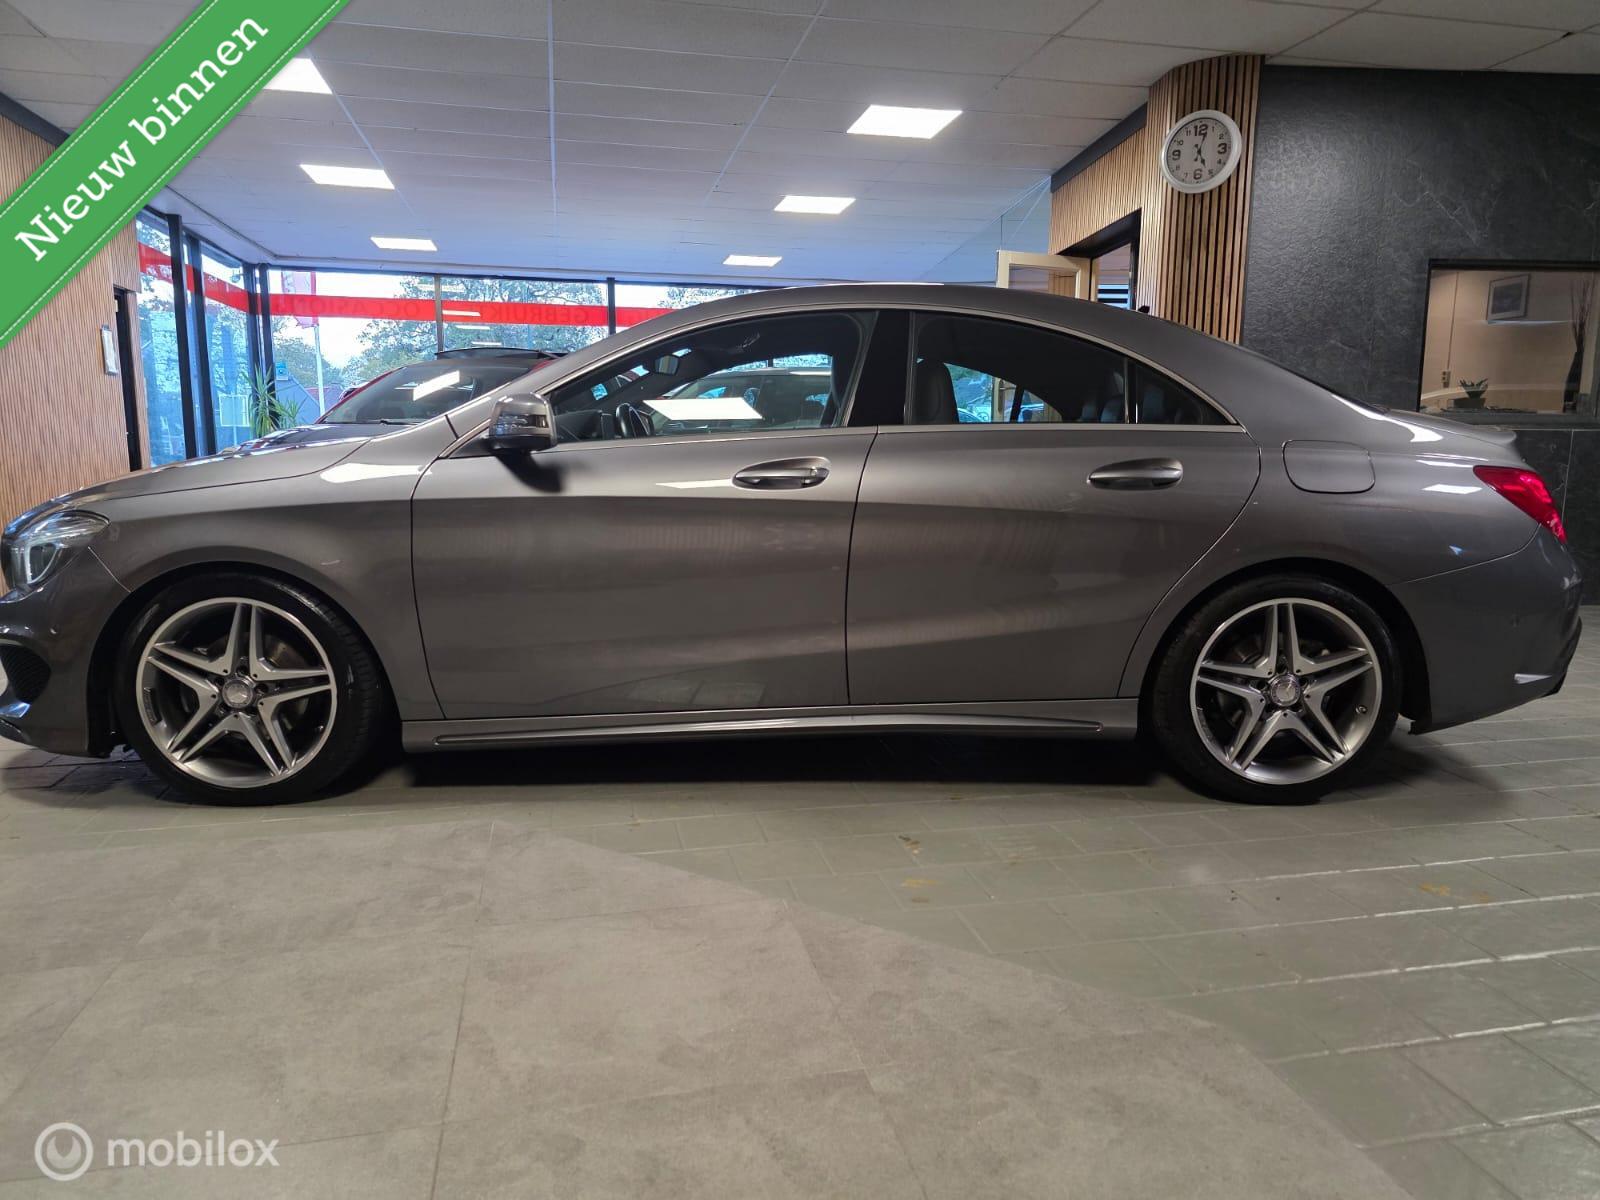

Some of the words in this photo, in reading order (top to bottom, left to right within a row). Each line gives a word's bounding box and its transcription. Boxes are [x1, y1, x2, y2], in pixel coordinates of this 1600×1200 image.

[1194, 124, 1208, 136] 12
[1217, 143, 1227, 154] 3
[1172, 149, 1181, 161] 9
[1193, 168, 1203, 180] 6
